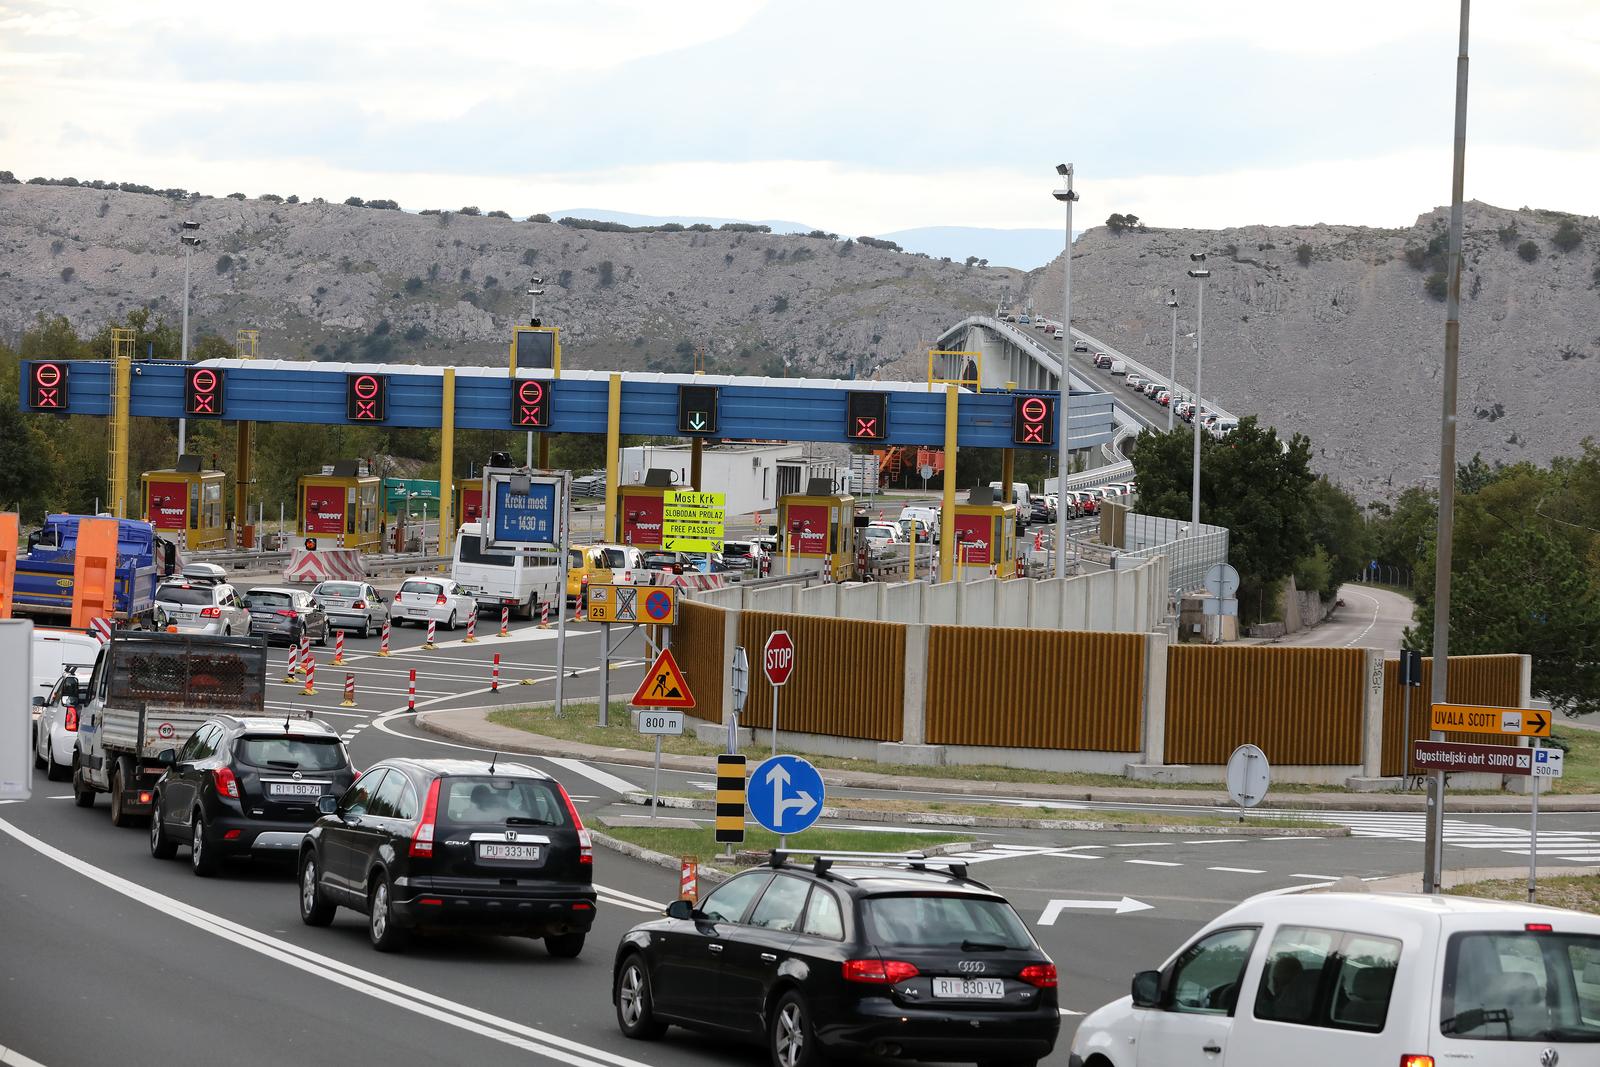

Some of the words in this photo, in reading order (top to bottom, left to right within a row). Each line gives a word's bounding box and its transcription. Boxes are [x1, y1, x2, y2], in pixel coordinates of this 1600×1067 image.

[527, 495, 548, 510] most
[674, 493, 695, 503] Most
[700, 494, 714, 504] Krk
[317, 512, 343, 520] TOMMY
[665, 509, 697, 518] SLOBODAN
[699, 510, 723, 520] PROLAZ
[504, 515, 509, 530] L
[518, 515, 536, 531] 1430
[538, 519, 546, 531] m
[670, 525, 686, 533] FREE
[688, 525, 716, 535] PASSAGE
[592, 607, 605, 617] 29
[767, 647, 792, 670] STOP
[645, 717, 665, 728] 800
[668, 720, 677, 728] m
[1434, 710, 1464, 726] UVALA
[1468, 712, 1496, 728] SCOTT
[1415, 749, 1466, 766] Ugostiteljski
[1467, 755, 1485, 765] obrt
[1487, 753, 1514, 767] SIDRO
[1536, 766, 1551, 776] 500
[275, 784, 285, 793] RI
[486, 845, 498, 856] PU
[504, 846, 537, 857] 333-NF
[941, 981, 953, 993] RI
[962, 981, 1002, 995] 830-VZ
